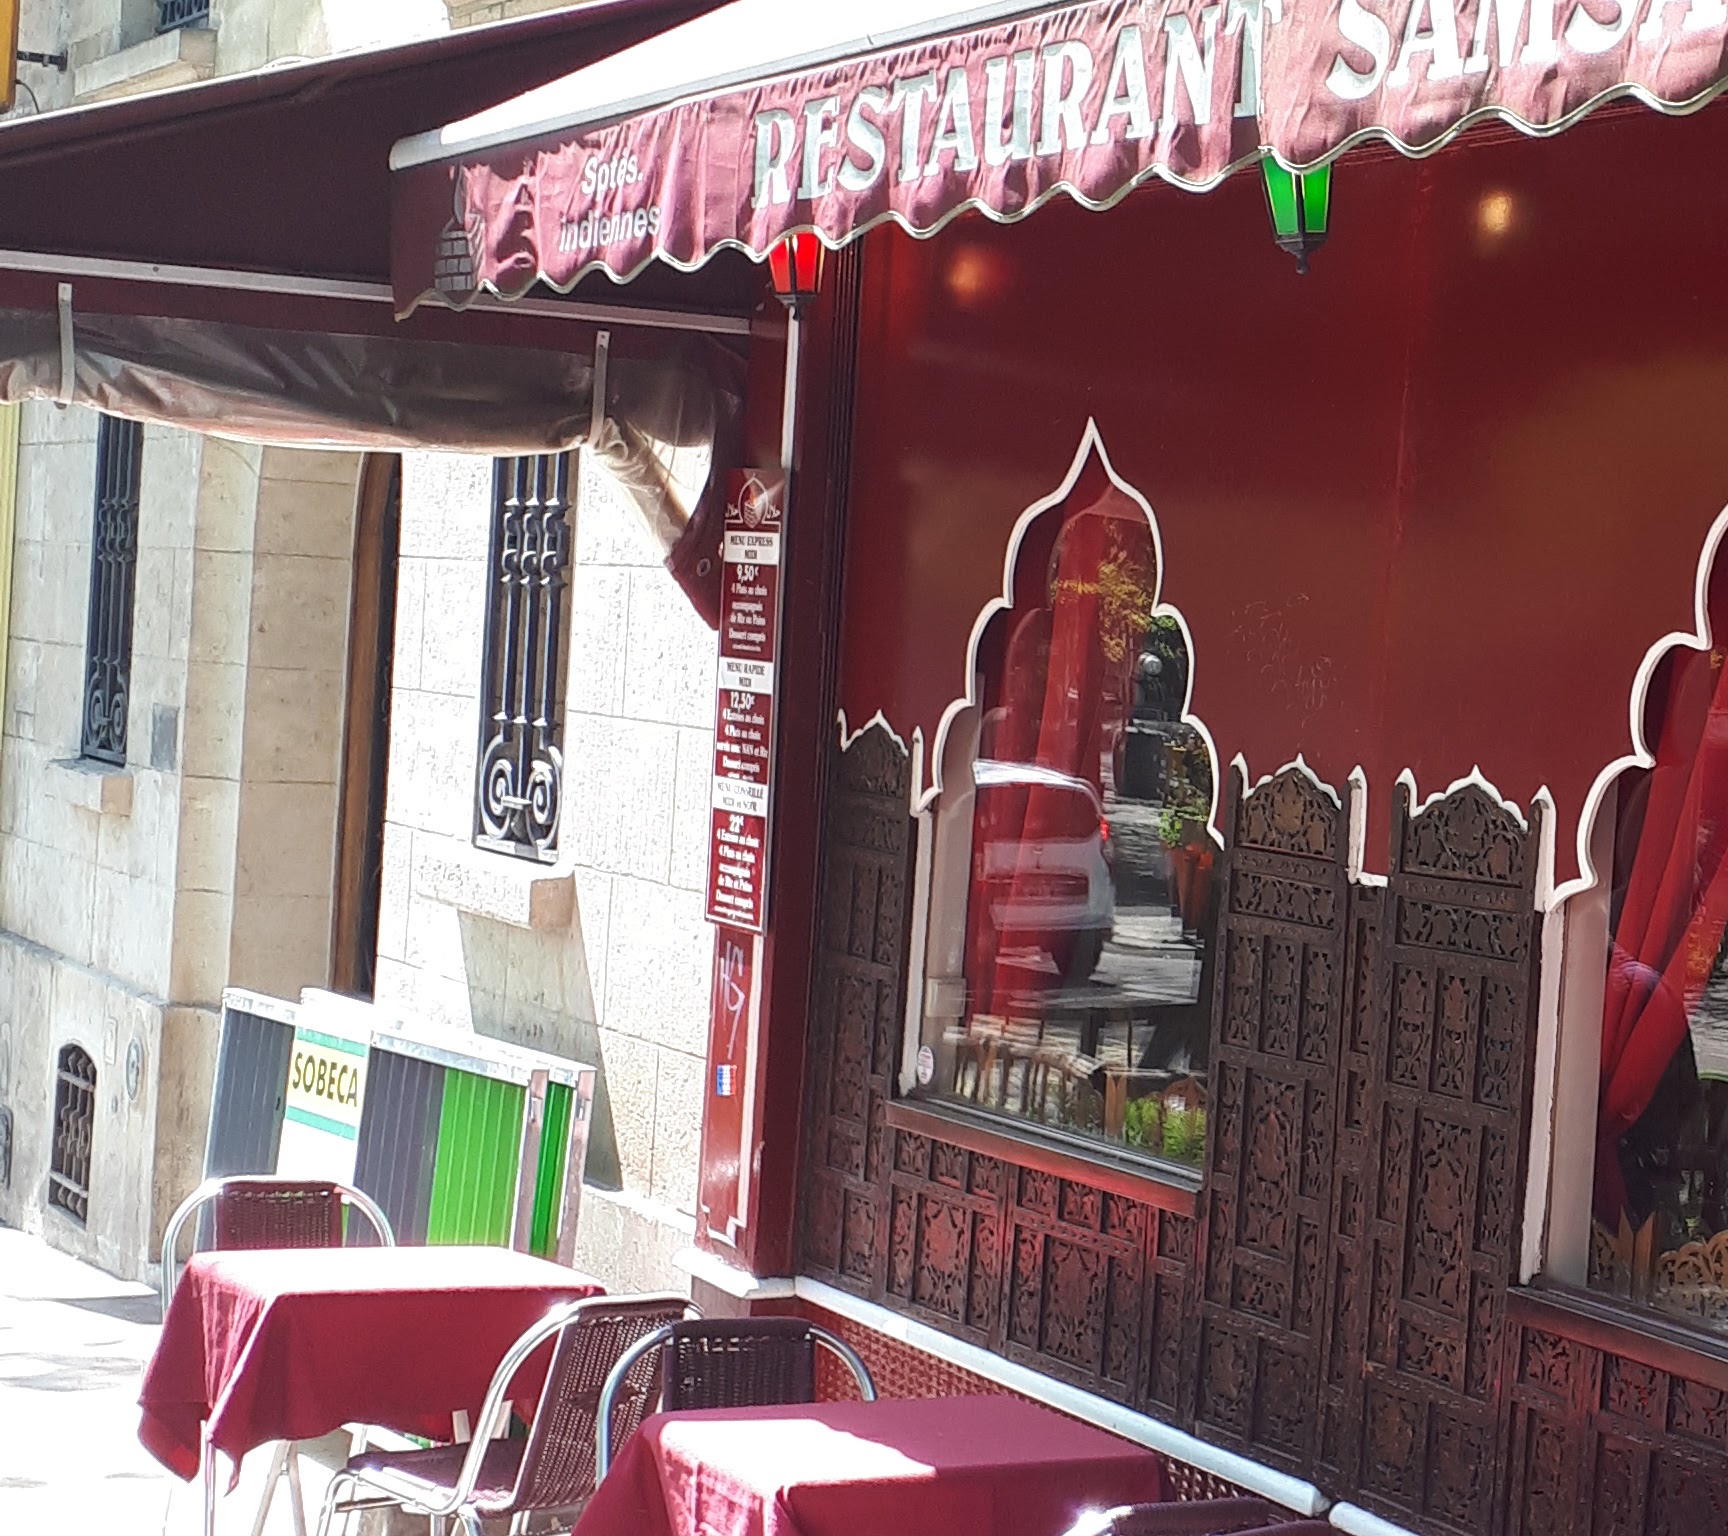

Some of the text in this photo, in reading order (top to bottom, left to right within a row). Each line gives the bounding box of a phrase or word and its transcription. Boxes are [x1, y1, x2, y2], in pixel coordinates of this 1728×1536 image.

[581, 152, 644, 203] Sptés.
[559, 204, 662, 253] indiennes
[291, 1051, 358, 1108] SOBECA
